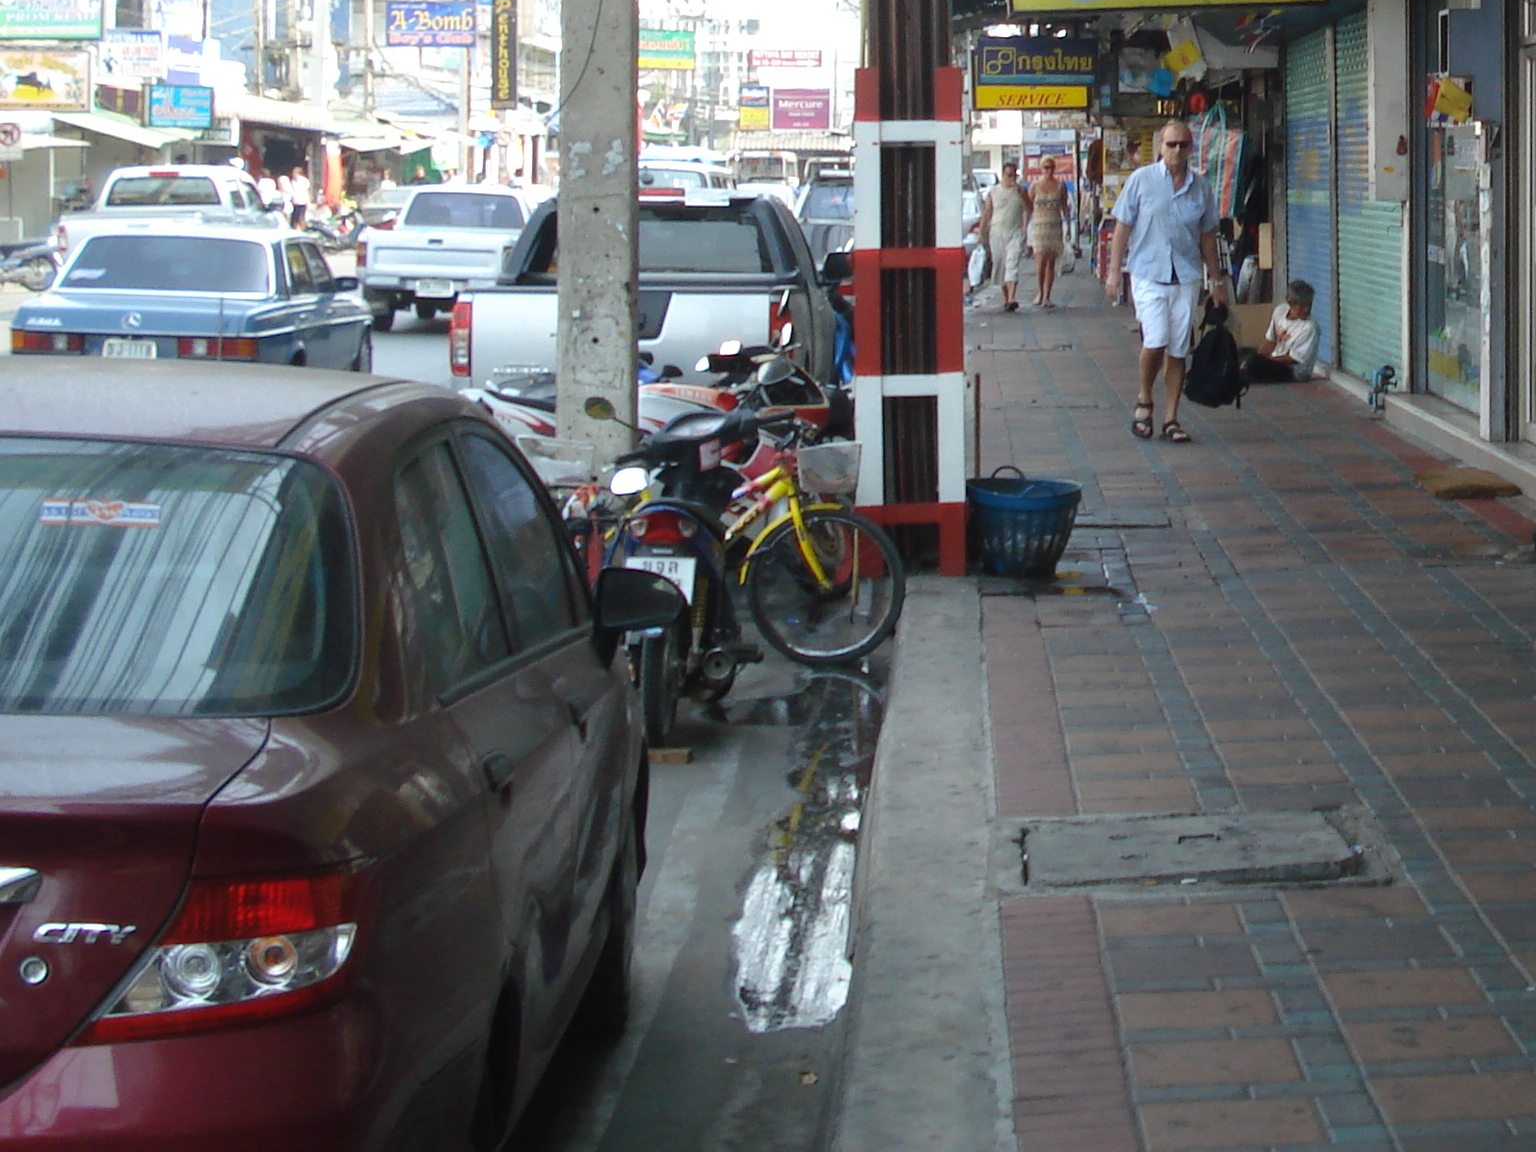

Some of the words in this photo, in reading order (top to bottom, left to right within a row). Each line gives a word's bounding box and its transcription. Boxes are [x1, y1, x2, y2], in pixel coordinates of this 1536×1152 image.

[389, 8, 474, 30] A-Bomb
[1016, 48, 1093, 77] กรุงไทย
[778, 100, 823, 109] Mercure
[996, 92, 1067, 106] SERVICE
[32, 922, 137, 945] CITY
